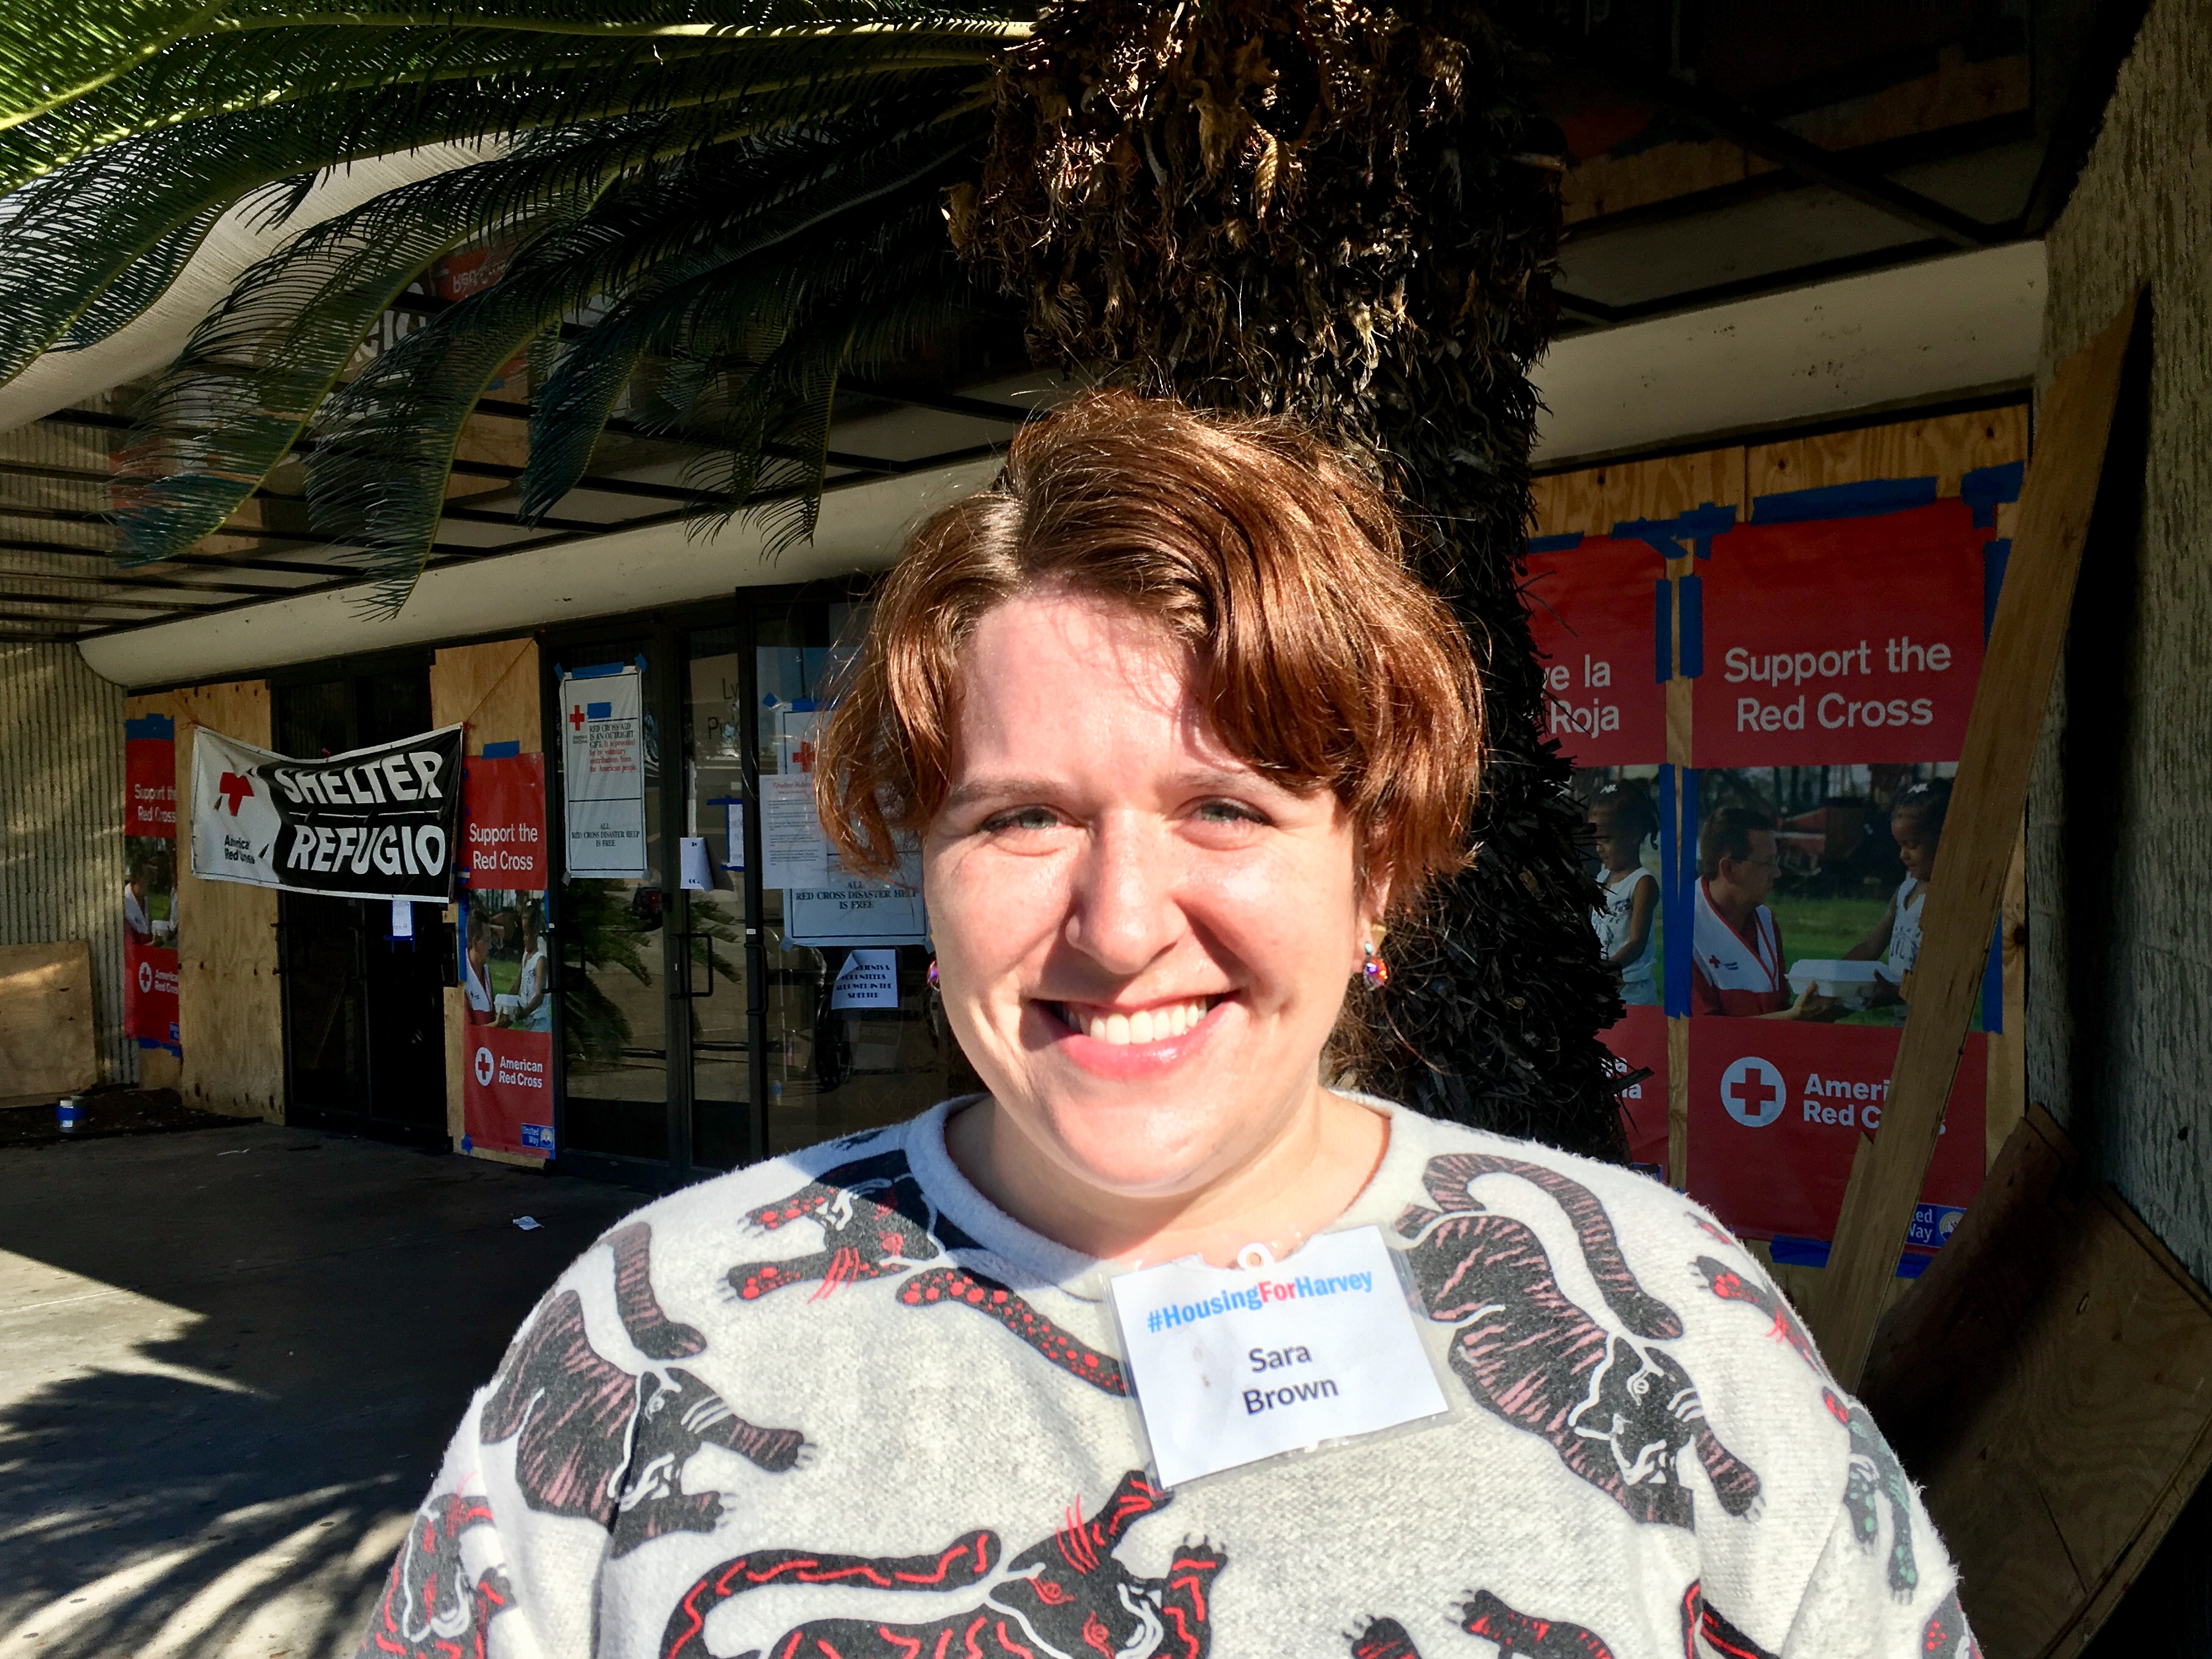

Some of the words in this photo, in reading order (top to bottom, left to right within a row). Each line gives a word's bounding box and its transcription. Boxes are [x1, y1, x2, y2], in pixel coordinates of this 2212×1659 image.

[1584, 654, 1611, 688] la
[1723, 640, 1872, 687] Support
[1885, 636, 1952, 672] the
[1551, 698, 1619, 739] Roja
[1737, 695, 1805, 731] Red
[1818, 693, 1933, 729] Cross
[274, 751, 443, 804] SHELTER
[134, 783, 166, 803] Support
[138, 805, 153, 822] Red
[469, 822, 516, 846] Support
[519, 822, 538, 843] the
[287, 824, 445, 876] REFUGIO
[473, 850, 497, 870] Red
[500, 850, 533, 870] Cross
[796, 892, 814, 901] RED
[817, 891, 846, 900] CROSS
[848, 890, 891, 899] DISASTER
[847, 880, 864, 889] ALL
[839, 901, 848, 909] IS
[851, 901, 875, 909] FREE
[500, 1056, 543, 1073] American
[499, 1070, 516, 1084] Red
[517, 1073, 542, 1088] Cross
[1803, 1073, 1890, 1101] Ameri
[1803, 1100, 1854, 1127] Red
[1148, 1271, 1373, 1334] #HousingForHarvey
[1248, 1345, 1312, 1374] Sara
[1242, 1379, 1340, 1416] Brown
